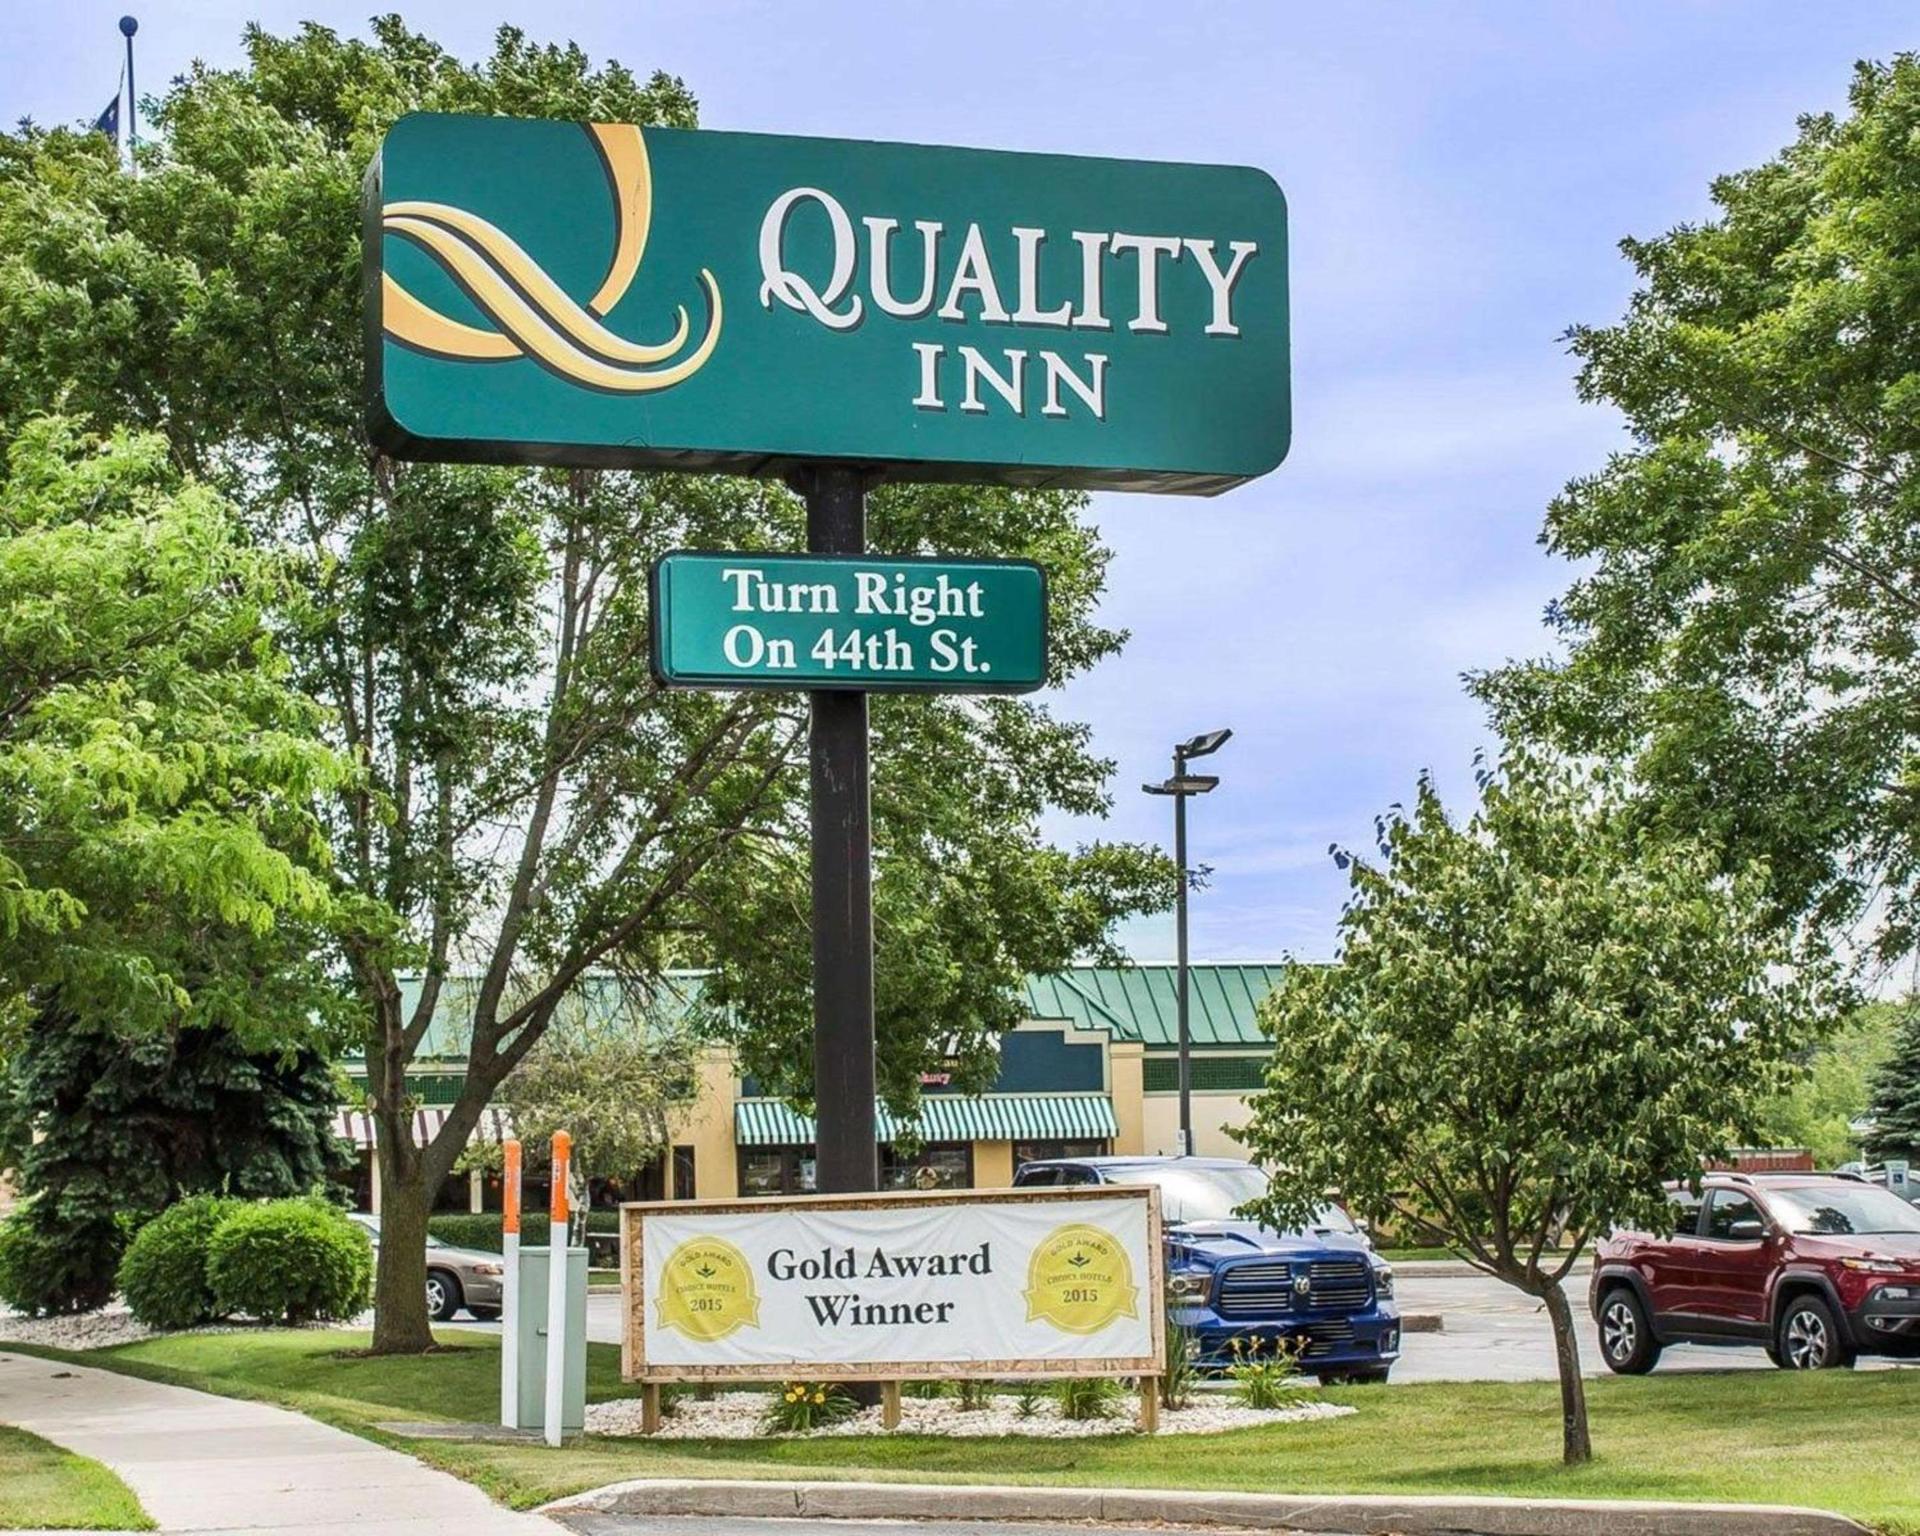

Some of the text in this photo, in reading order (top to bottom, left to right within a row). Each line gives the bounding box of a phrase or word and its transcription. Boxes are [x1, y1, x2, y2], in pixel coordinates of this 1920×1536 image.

[758, 187, 1258, 335] QUALITY
[912, 342, 1108, 420] INN
[722, 568, 985, 626] Turn Right
[722, 624, 992, 673] On 44th St.
[767, 1241, 993, 1281] Gold Award
[689, 1298, 723, 1312] 2015
[805, 1293, 955, 1327] Winner
[1062, 1289, 1098, 1303] 2015
